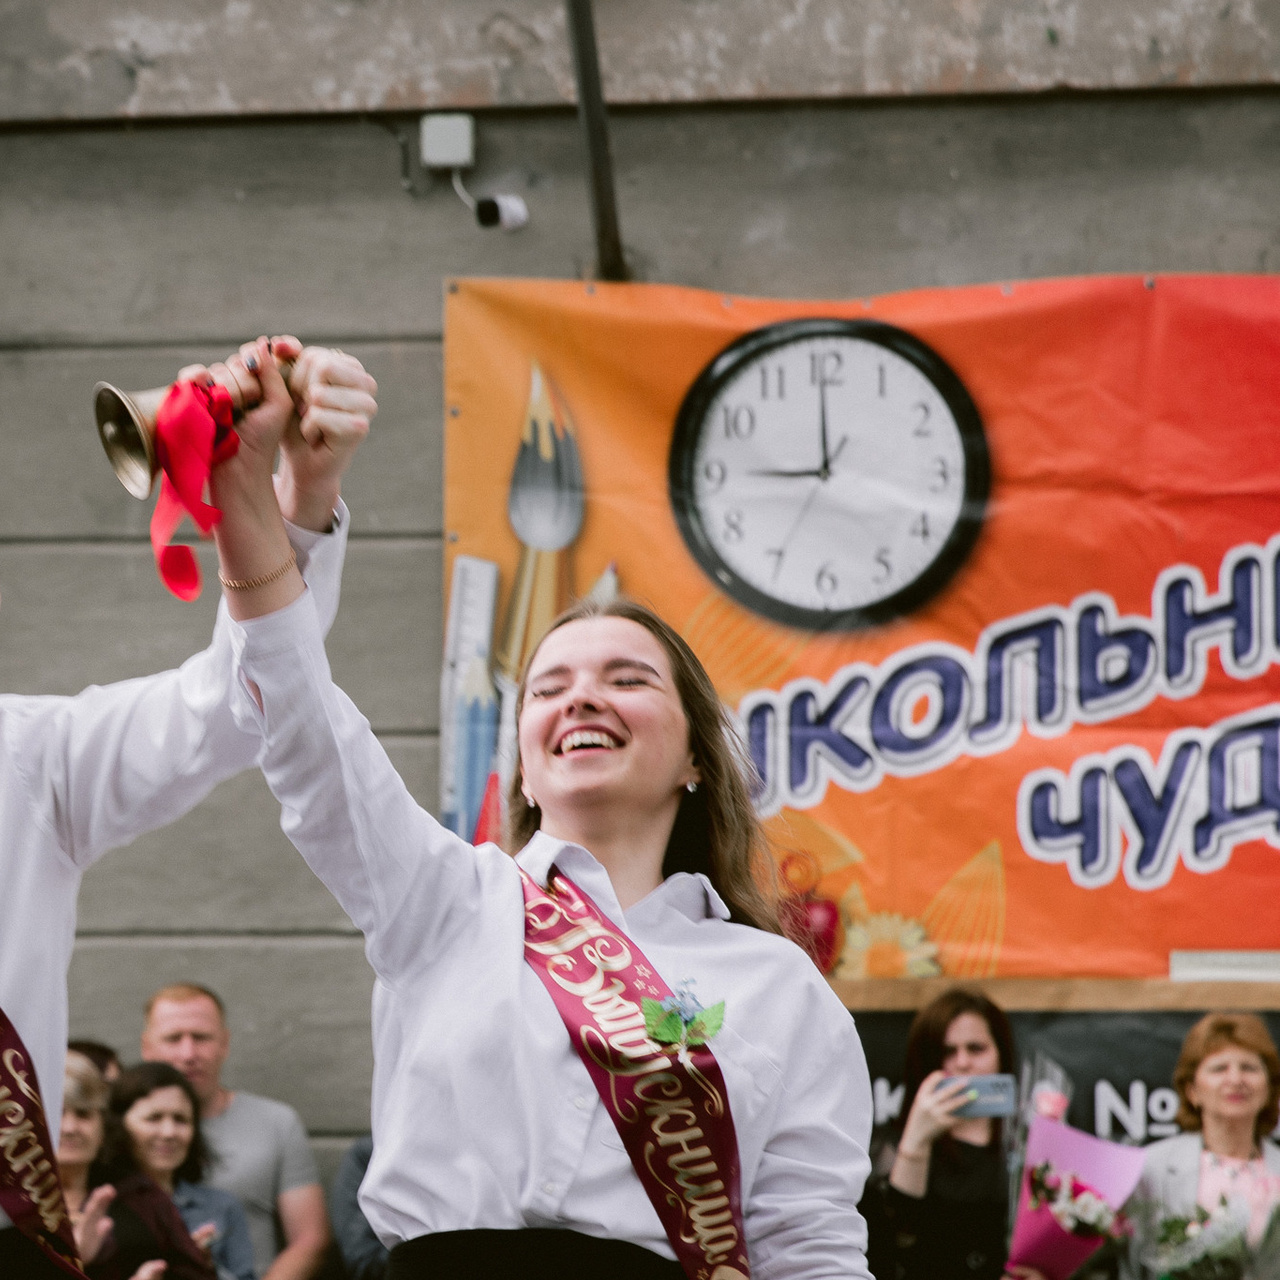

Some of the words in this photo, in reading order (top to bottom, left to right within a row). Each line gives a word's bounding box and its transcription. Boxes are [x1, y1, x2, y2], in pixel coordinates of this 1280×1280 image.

[760, 364, 786, 401] 11
[809, 349, 843, 386] 12
[877, 362, 887, 398] 1
[722, 405, 756, 439] 10
[913, 401, 931, 438] 2
[704, 459, 727, 493] 9
[929, 457, 949, 493] 3
[723, 509, 744, 543] 8
[910, 512, 930, 544] 4
[766, 547, 785, 582] 7
[815, 560, 838, 596] 6
[873, 546, 891, 584] 5
[742, 546, 1280, 805] КОЛЬН
[523, 885, 738, 1265] Выпускница
